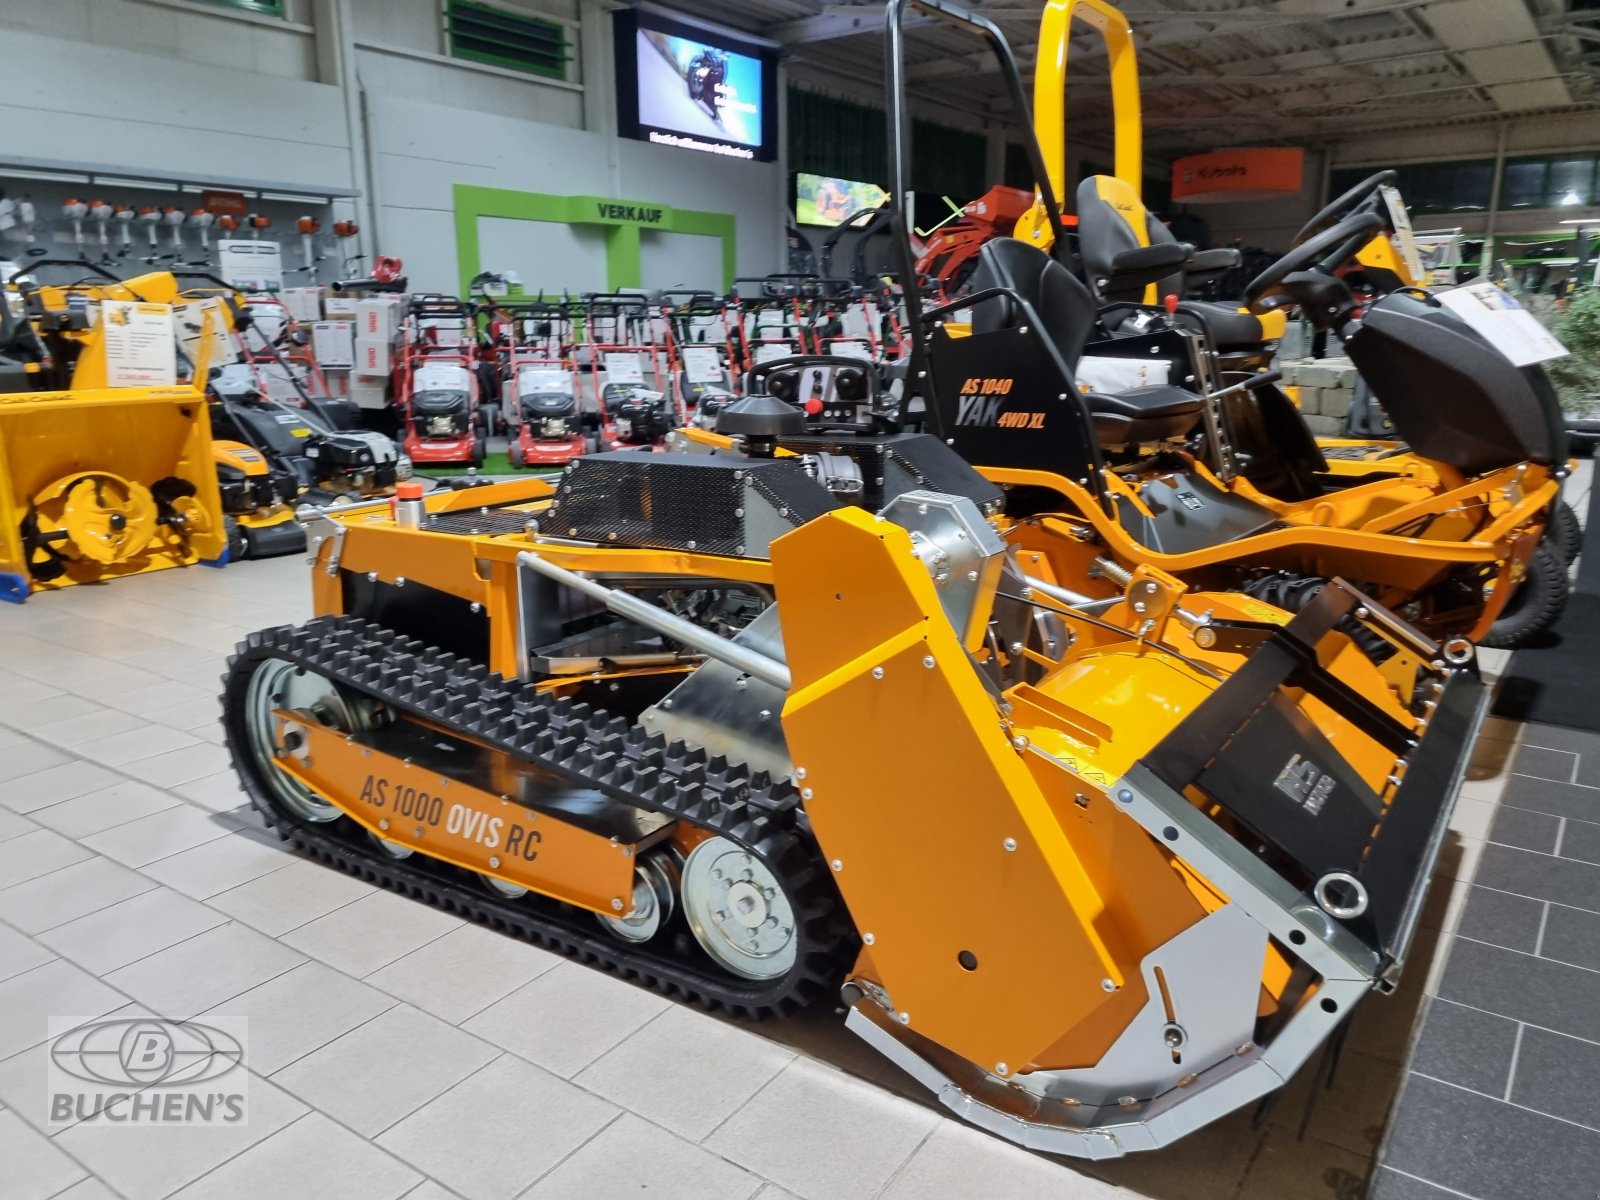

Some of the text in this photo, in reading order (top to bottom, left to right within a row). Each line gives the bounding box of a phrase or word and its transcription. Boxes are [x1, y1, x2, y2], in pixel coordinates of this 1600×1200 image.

[597, 203, 664, 224] VERKAUF
[960, 378, 1014, 395] AS 1040
[955, 396, 1046, 429] YAK 4WD XL
[360, 775, 542, 862] AS 1000 OVIS RC
